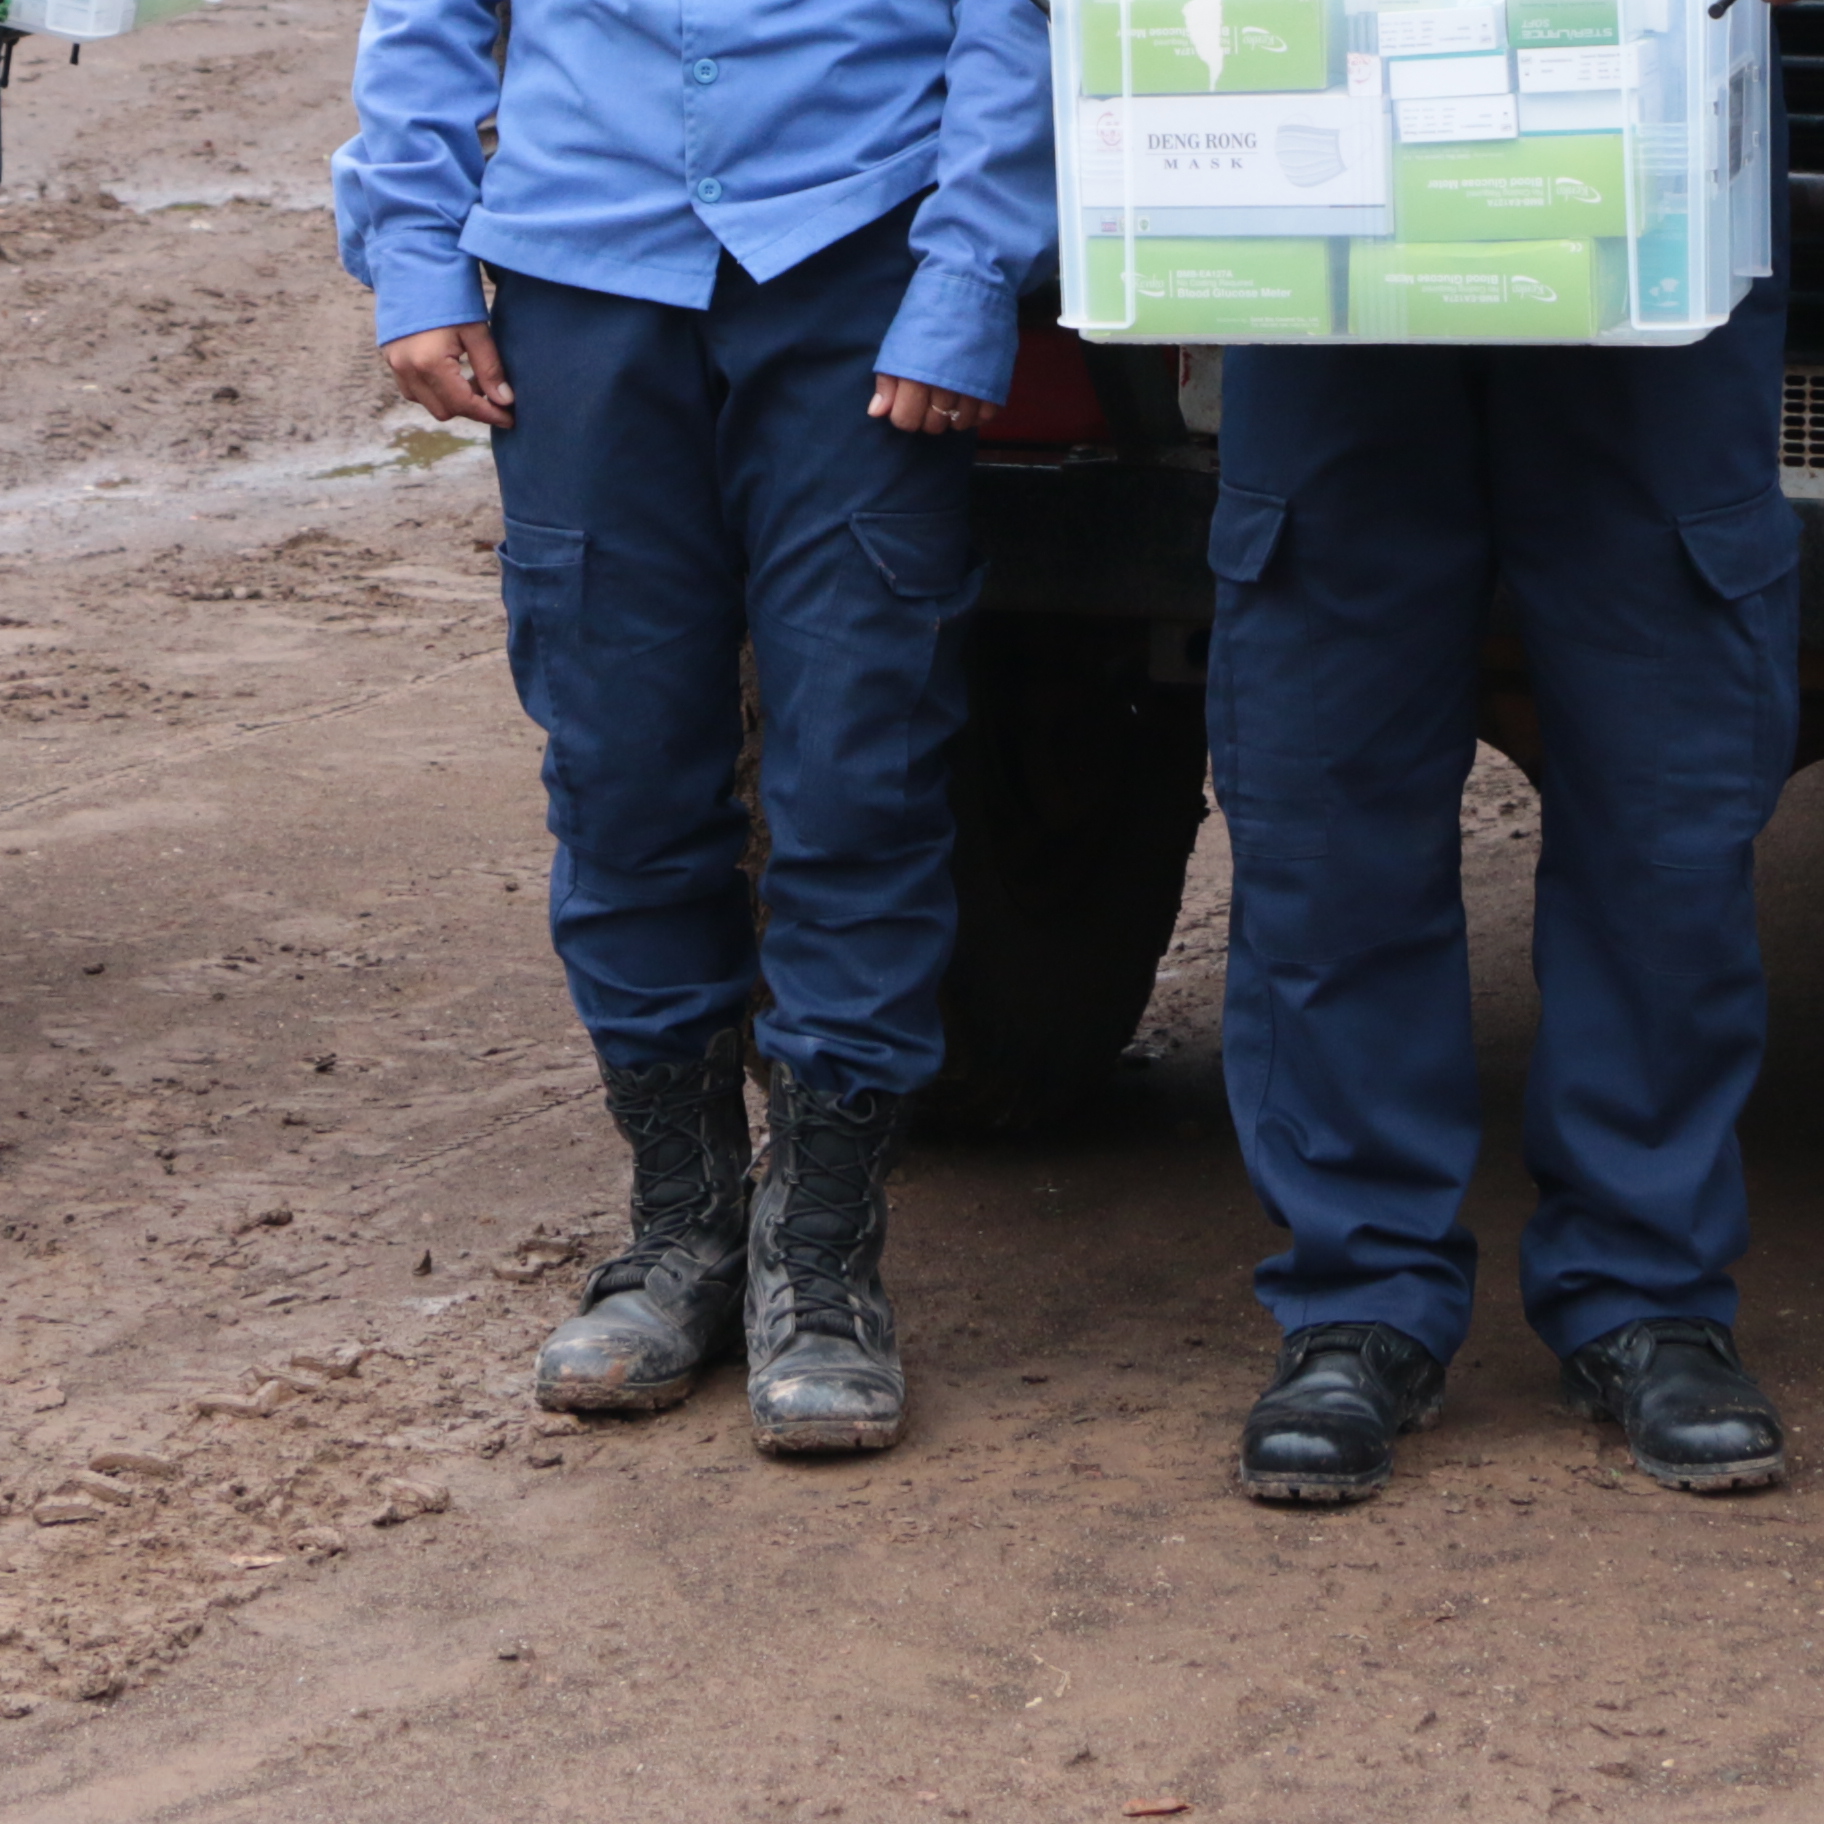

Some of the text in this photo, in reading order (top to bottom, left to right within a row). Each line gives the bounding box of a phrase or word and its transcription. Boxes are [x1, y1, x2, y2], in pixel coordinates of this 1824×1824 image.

[1521, 18, 1550, 28] SOFT
[1147, 132, 1258, 150] DENG RONG
[1163, 157, 1244, 170] MASK
[1427, 177, 1543, 190] Blood Glucose Meter
[1417, 274, 1463, 285] Glucose
[1465, 274, 1499, 285] Blood
[1177, 288, 1292, 298] Blood Glucose Meter
